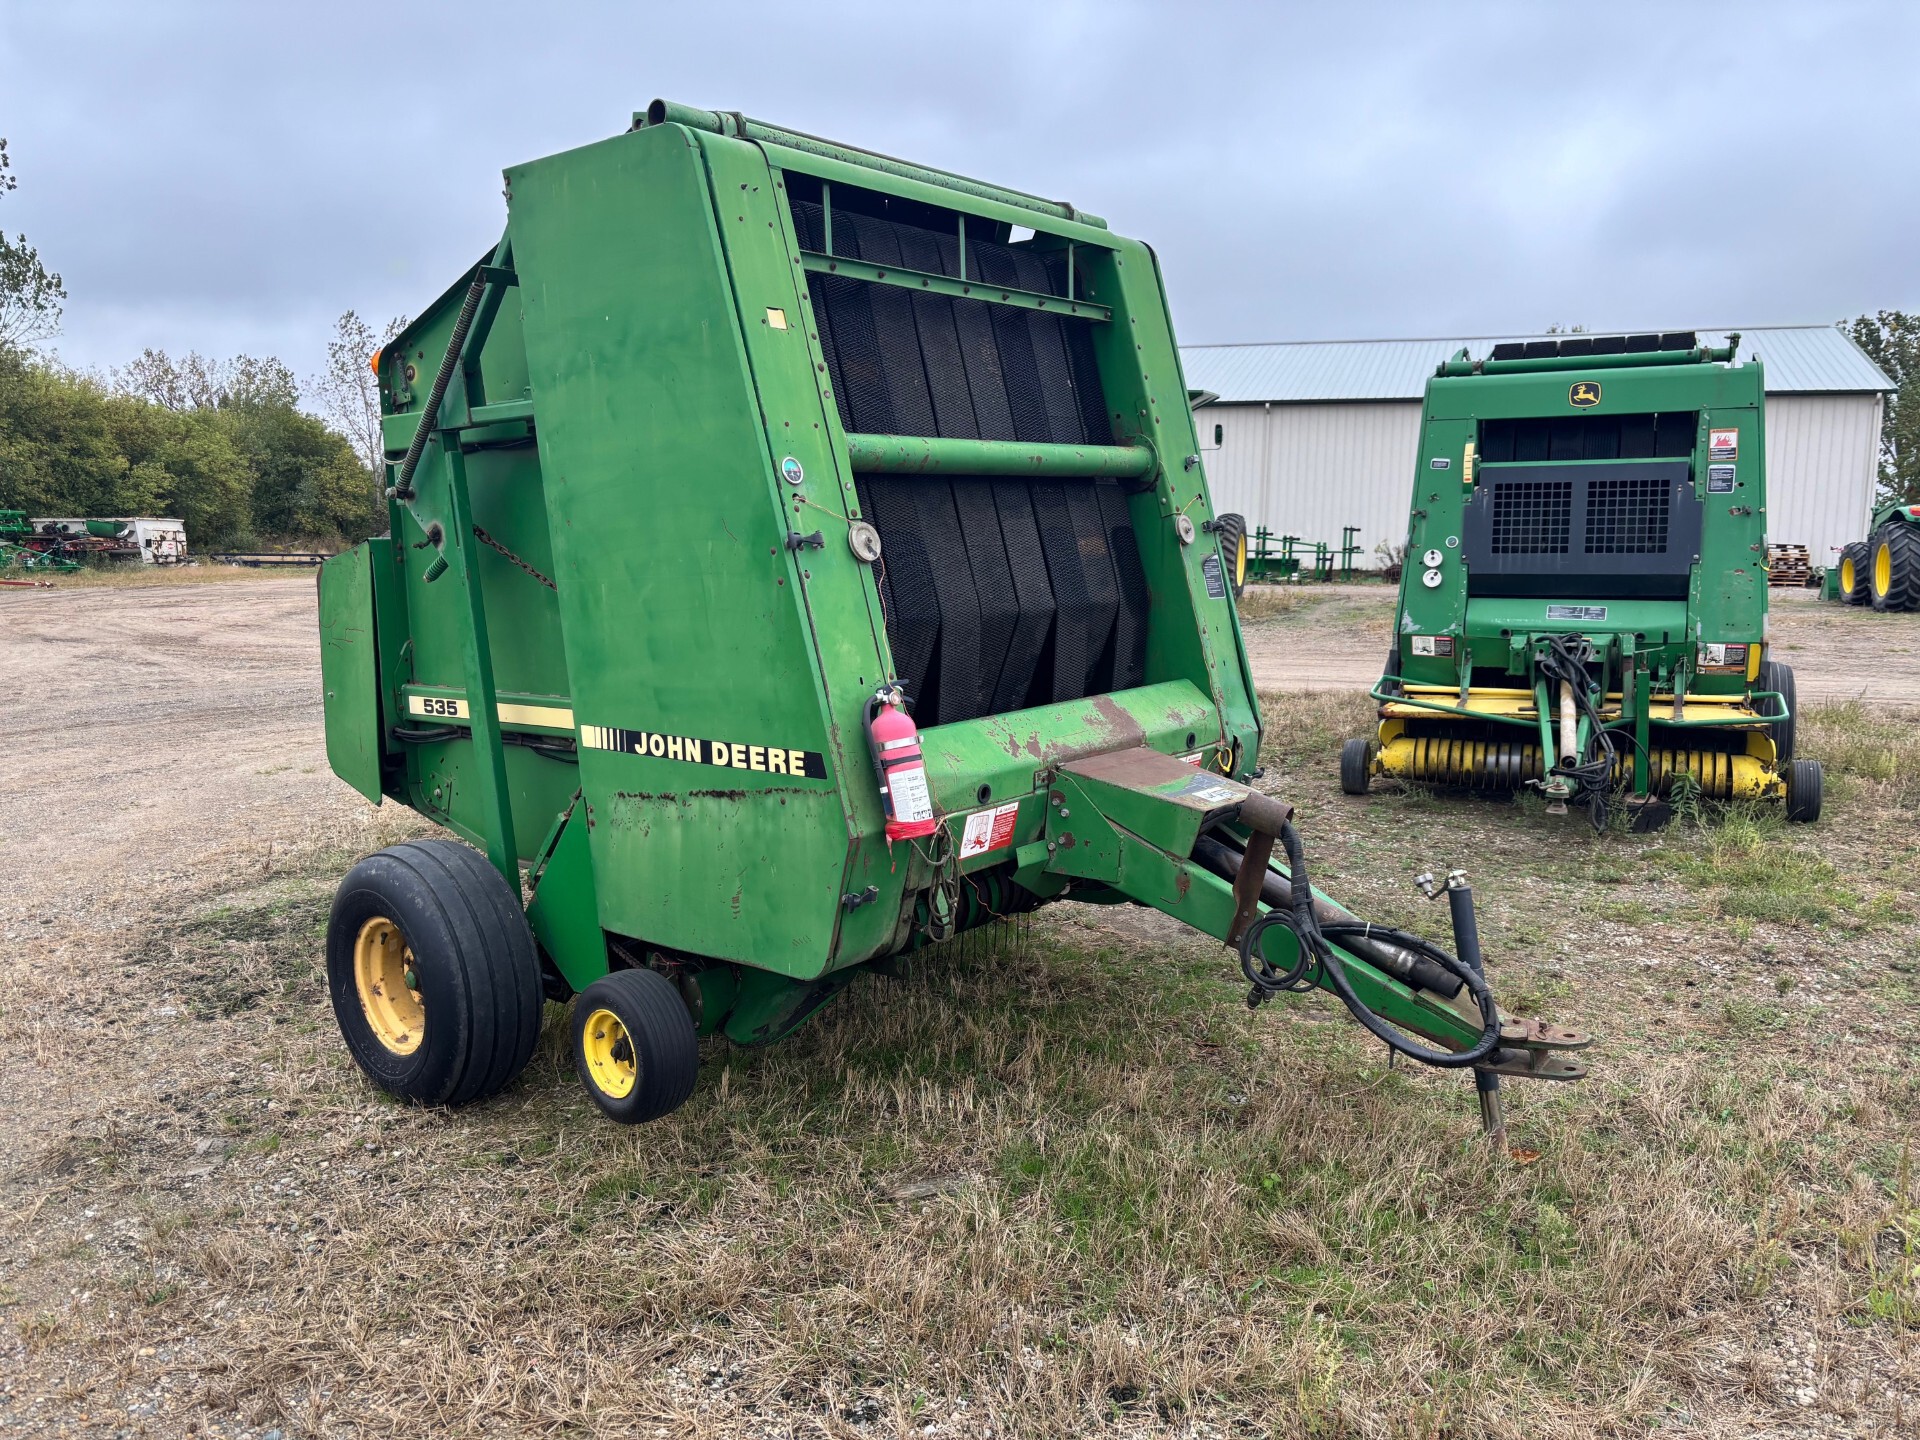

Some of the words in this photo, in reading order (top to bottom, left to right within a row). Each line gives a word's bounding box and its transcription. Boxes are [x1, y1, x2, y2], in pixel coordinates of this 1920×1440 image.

[423, 698, 458, 716] 535
[634, 732, 702, 763] JOHN
[711, 741, 806, 777] DEERE
